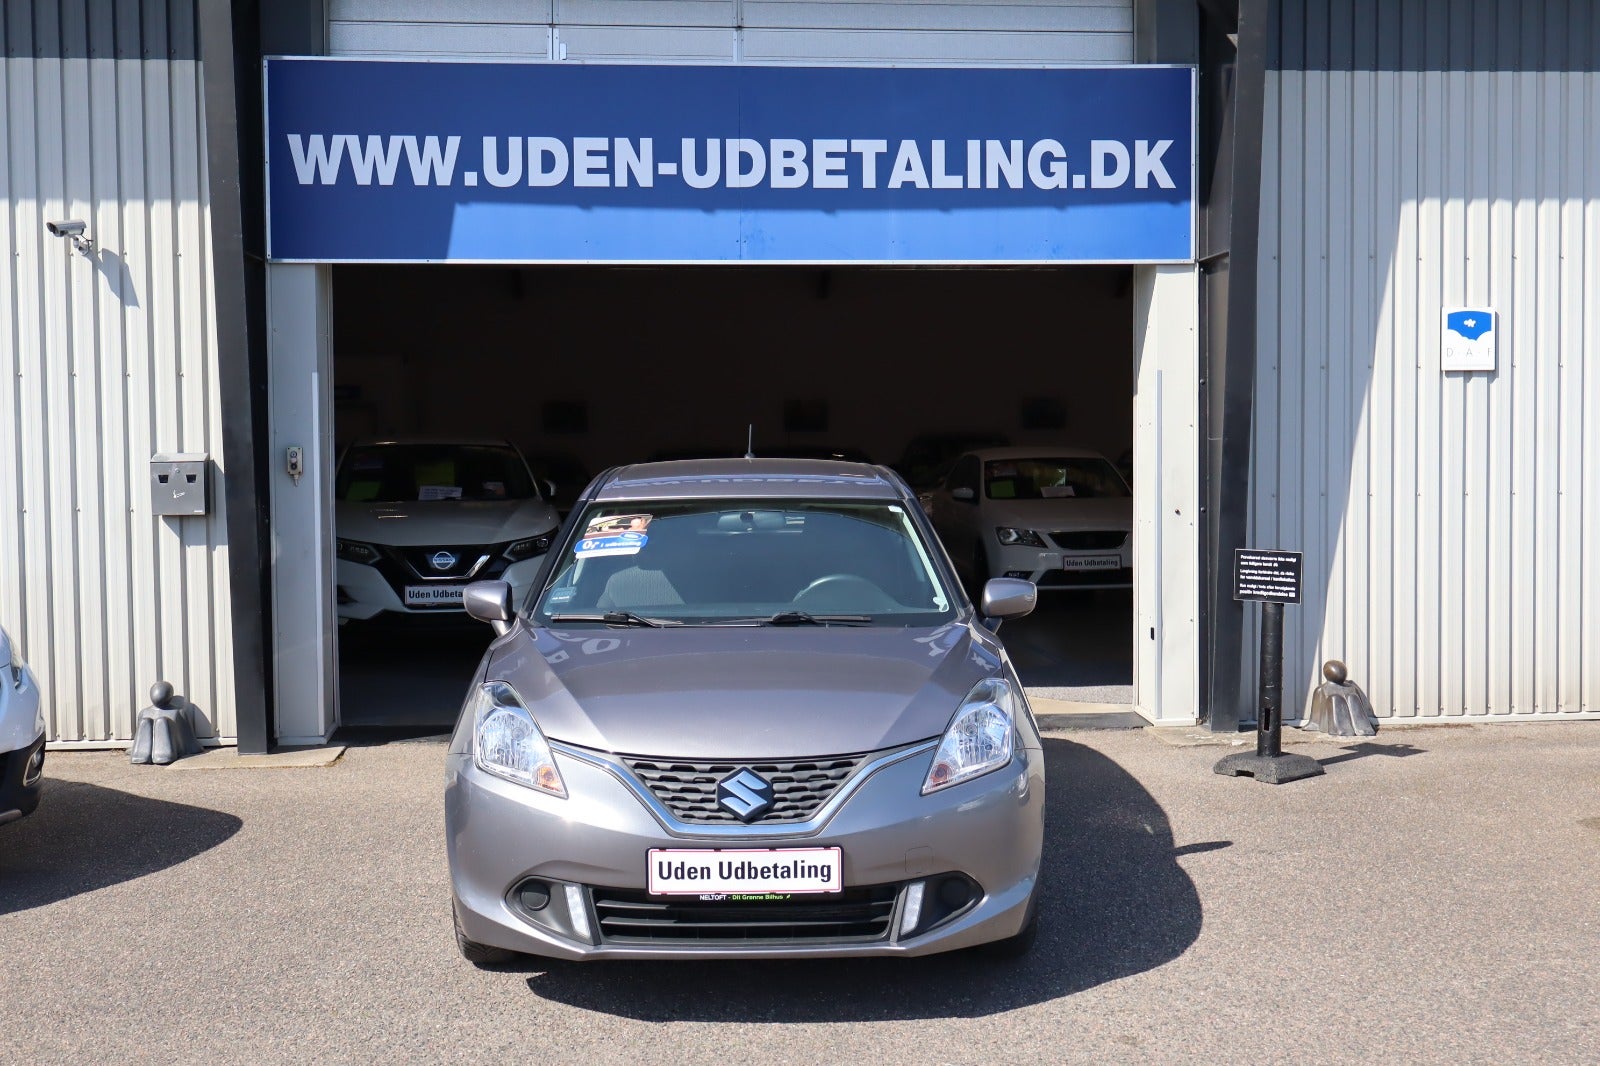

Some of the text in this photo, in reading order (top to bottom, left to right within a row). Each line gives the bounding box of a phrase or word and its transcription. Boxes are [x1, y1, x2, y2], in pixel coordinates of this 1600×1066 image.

[286, 133, 1177, 190] WWW.UDEN-UDBETALING.DK
[1066, 559, 1083, 567] Uden
[408, 590, 430, 599] Uden
[658, 859, 831, 883] Uden Udbetaling
